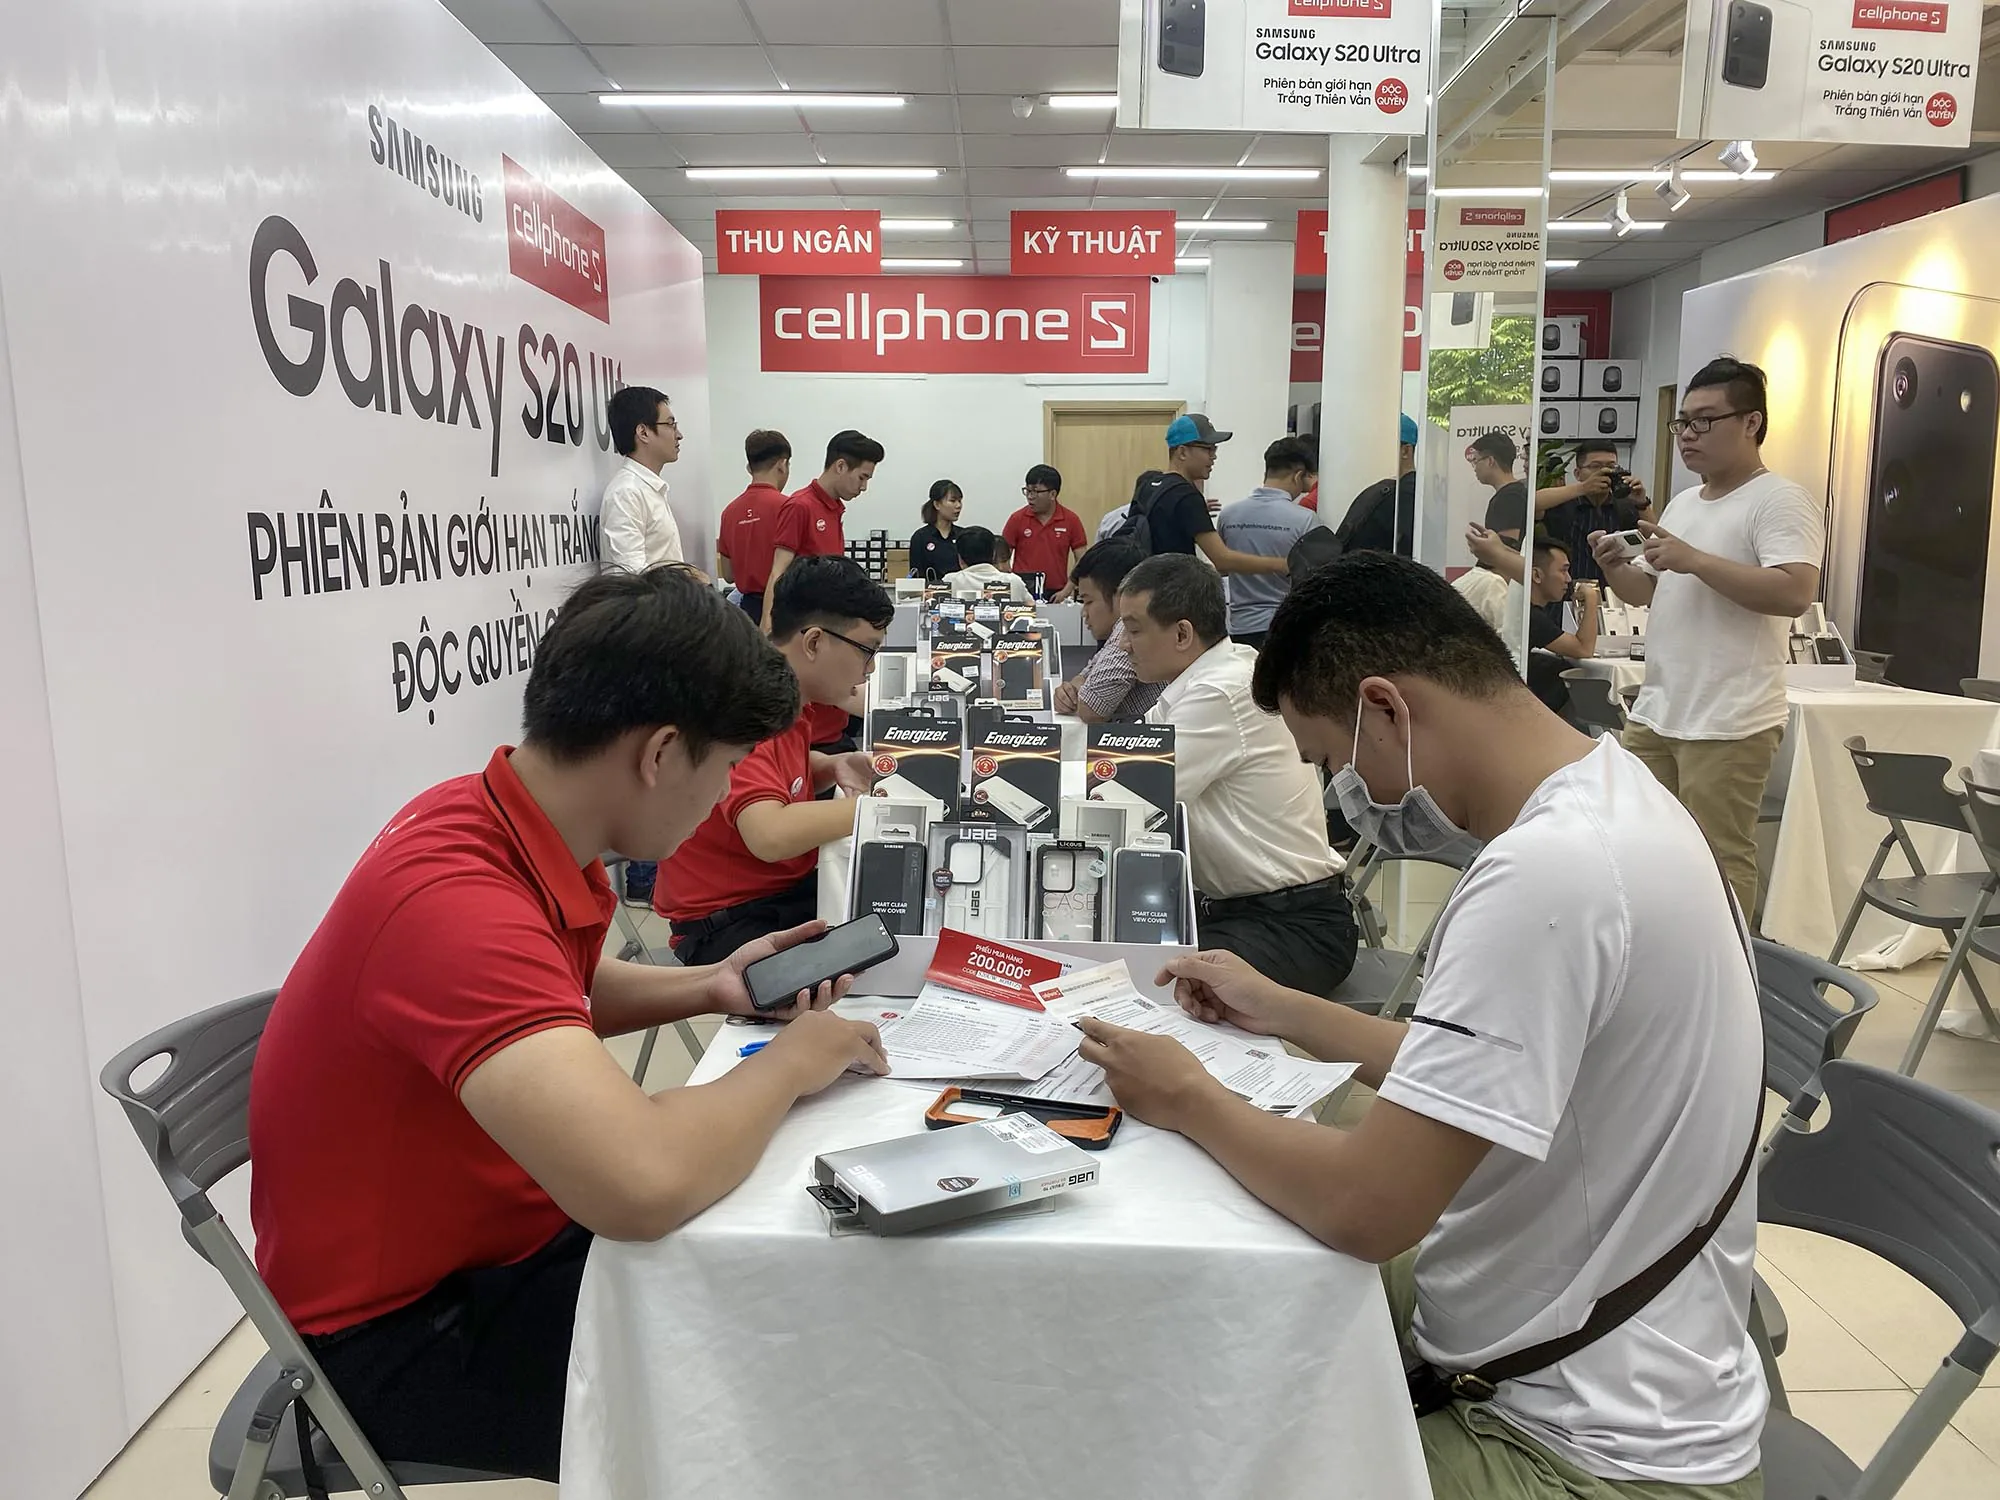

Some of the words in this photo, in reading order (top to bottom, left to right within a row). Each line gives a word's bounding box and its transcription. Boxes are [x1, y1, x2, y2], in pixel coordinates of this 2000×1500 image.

[1859, 6, 1928, 23] cellphone
[1931, 11, 1940, 24] S
[1256, 28, 1316, 39] SAMSUNG
[1255, 42, 1331, 66] Galaxy
[1334, 44, 1369, 62] S20
[1373, 45, 1421, 63] Ultra
[1820, 40, 1876, 52] SAMSUNG
[1818, 54, 1889, 78] Galaxy
[1892, 57, 1924, 76] S20
[1927, 59, 1970, 78] Ultra
[1264, 78, 1296, 89] Phiên
[1299, 78, 1322, 89] bản
[1325, 79, 1347, 93] giới
[1349, 80, 1371, 93] hạn
[1381, 84, 1402, 96] ĐỘC
[1823, 89, 1854, 101] Phiên
[1277, 90, 1311, 106] Trắng
[1315, 93, 1346, 105] Thiên
[1377, 94, 1406, 106] QUYỀN
[1870, 106, 1900, 118] Thiên
[368, 104, 483, 223] SAMSUNG
[513, 201, 590, 279] cellphone
[592, 249, 602, 293] S
[725, 229, 784, 254] THU
[793, 225, 873, 254] NGÂN
[1023, 226, 1061, 254] KỸ
[1067, 225, 1162, 260] THUẬT
[774, 293, 1070, 356] cellphone
[1090, 301, 1127, 349] S
[250, 216, 504, 477] Galaxy
[518, 324, 584, 447] S20
[247, 489, 369, 600] PHIÊN
[375, 490, 442, 586] BẢN
[447, 496, 501, 578] GIỚI
[504, 514, 547, 588] HẠN
[392, 616, 462, 725] ĐỘC
[1043, 893, 1098, 910] CASE
[992, 948, 1005, 959] MUA
[967, 951, 1032, 980] 200.000đ
